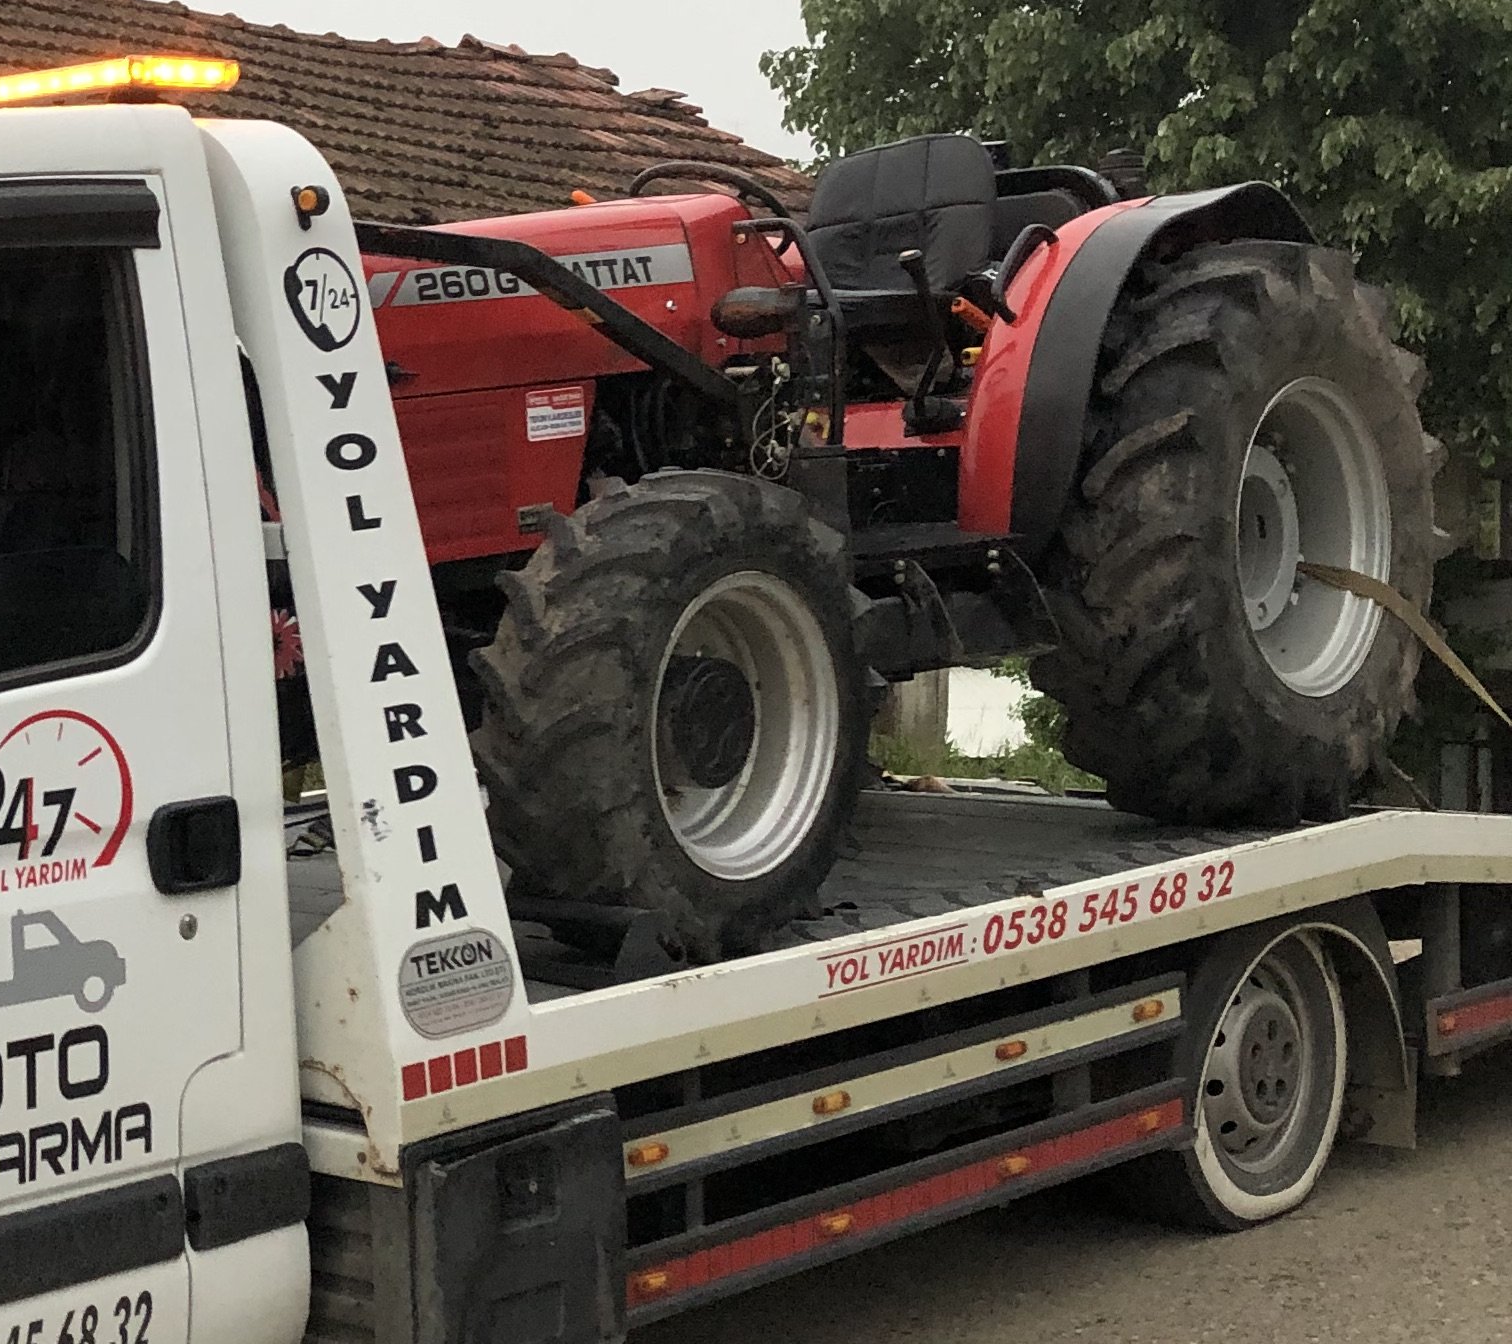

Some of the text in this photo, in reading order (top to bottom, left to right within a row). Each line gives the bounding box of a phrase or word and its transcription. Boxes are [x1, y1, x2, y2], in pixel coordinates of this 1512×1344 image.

[560, 256, 652, 288] ATTAT
[304, 273, 350, 323] 7/24
[316, 371, 382, 532] YOL
[356, 580, 468, 930] YARDIM
[14, 857, 87, 889] YARDIM
[825, 958, 870, 989] YOL
[878, 932, 964, 975] YARDIM
[982, 900, 1068, 955] 0538
[1078, 884, 1140, 934] 545
[1149, 872, 1188, 915] 68
[1197, 860, 1235, 902] 32
